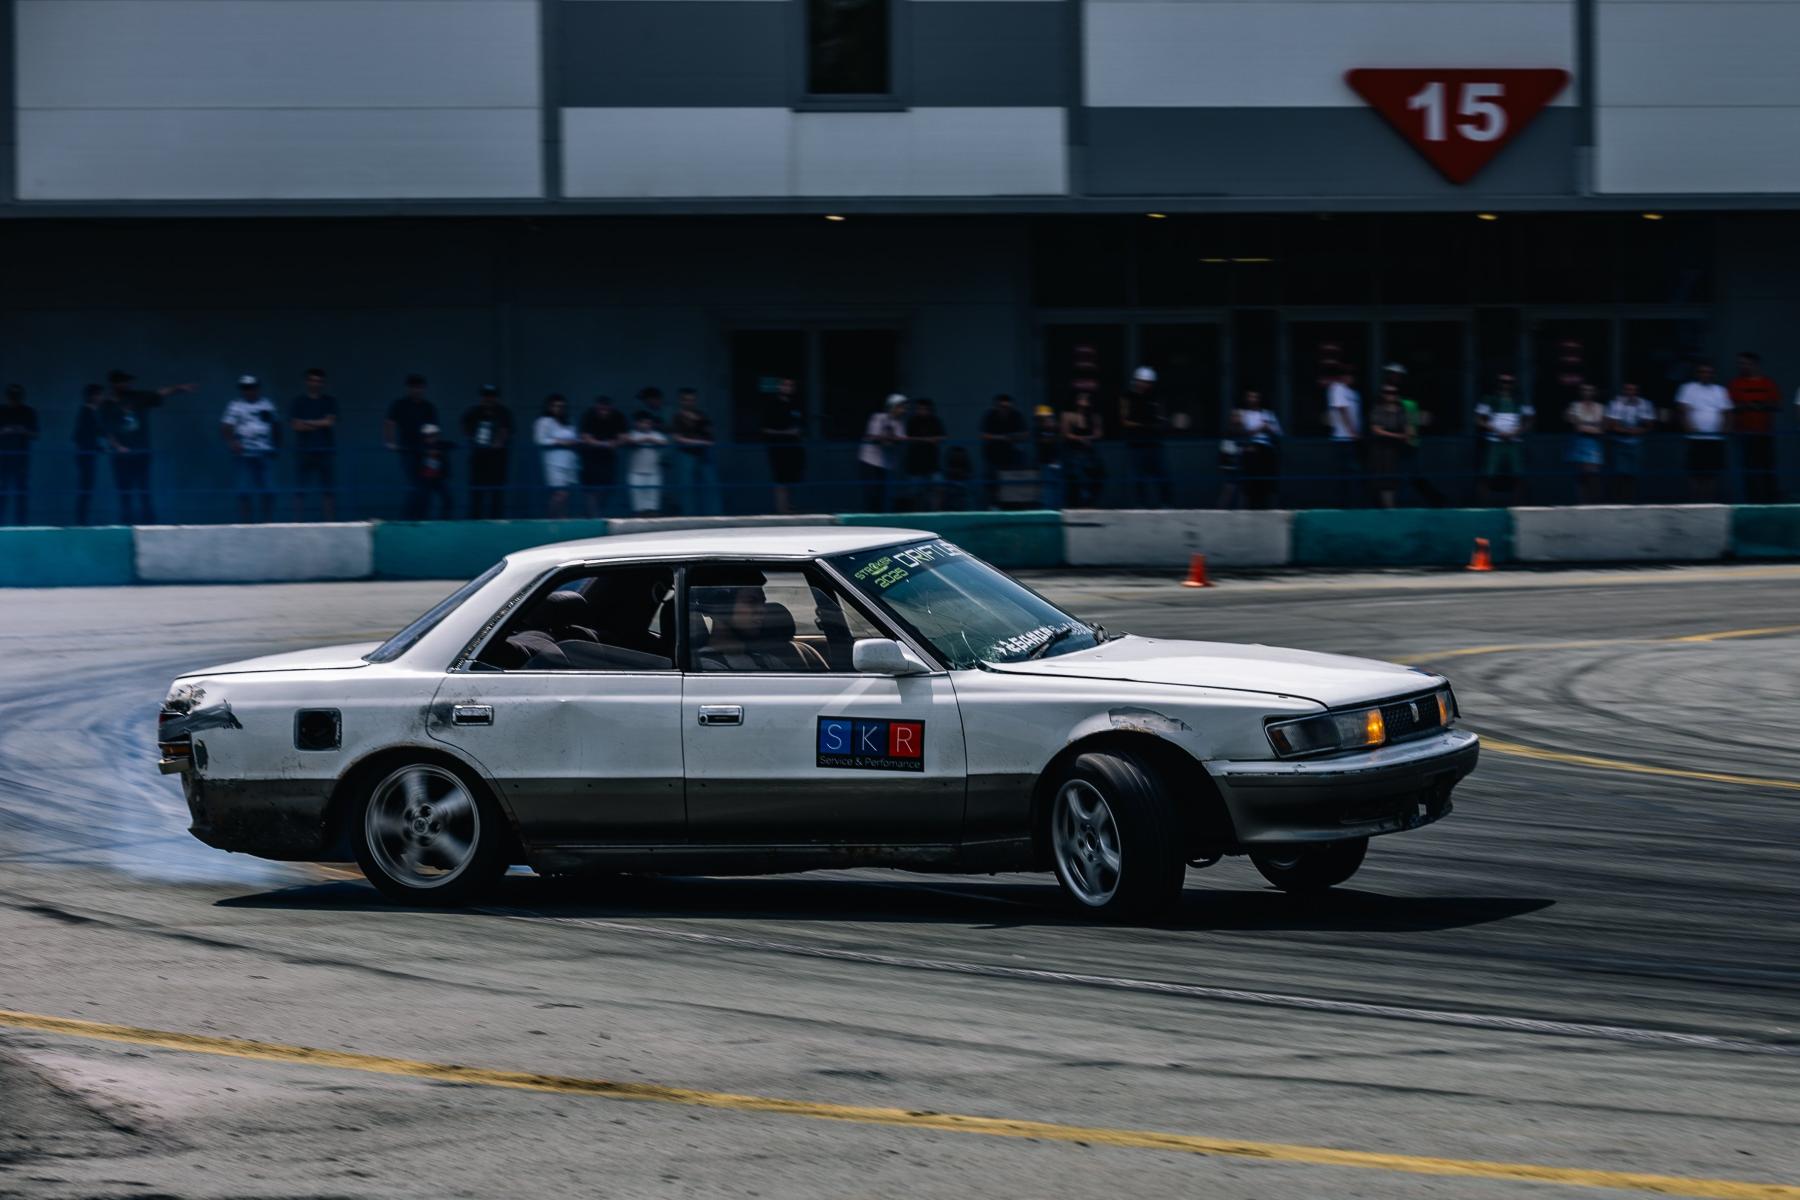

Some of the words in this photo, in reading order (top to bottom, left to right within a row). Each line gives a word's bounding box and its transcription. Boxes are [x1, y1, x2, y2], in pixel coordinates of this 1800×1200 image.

[1407, 81, 1508, 142] 15
[892, 545, 945, 568] DRIFT
[874, 567, 909, 588] 2025
[820, 755, 853, 766] Service
[855, 757, 863, 767] &
